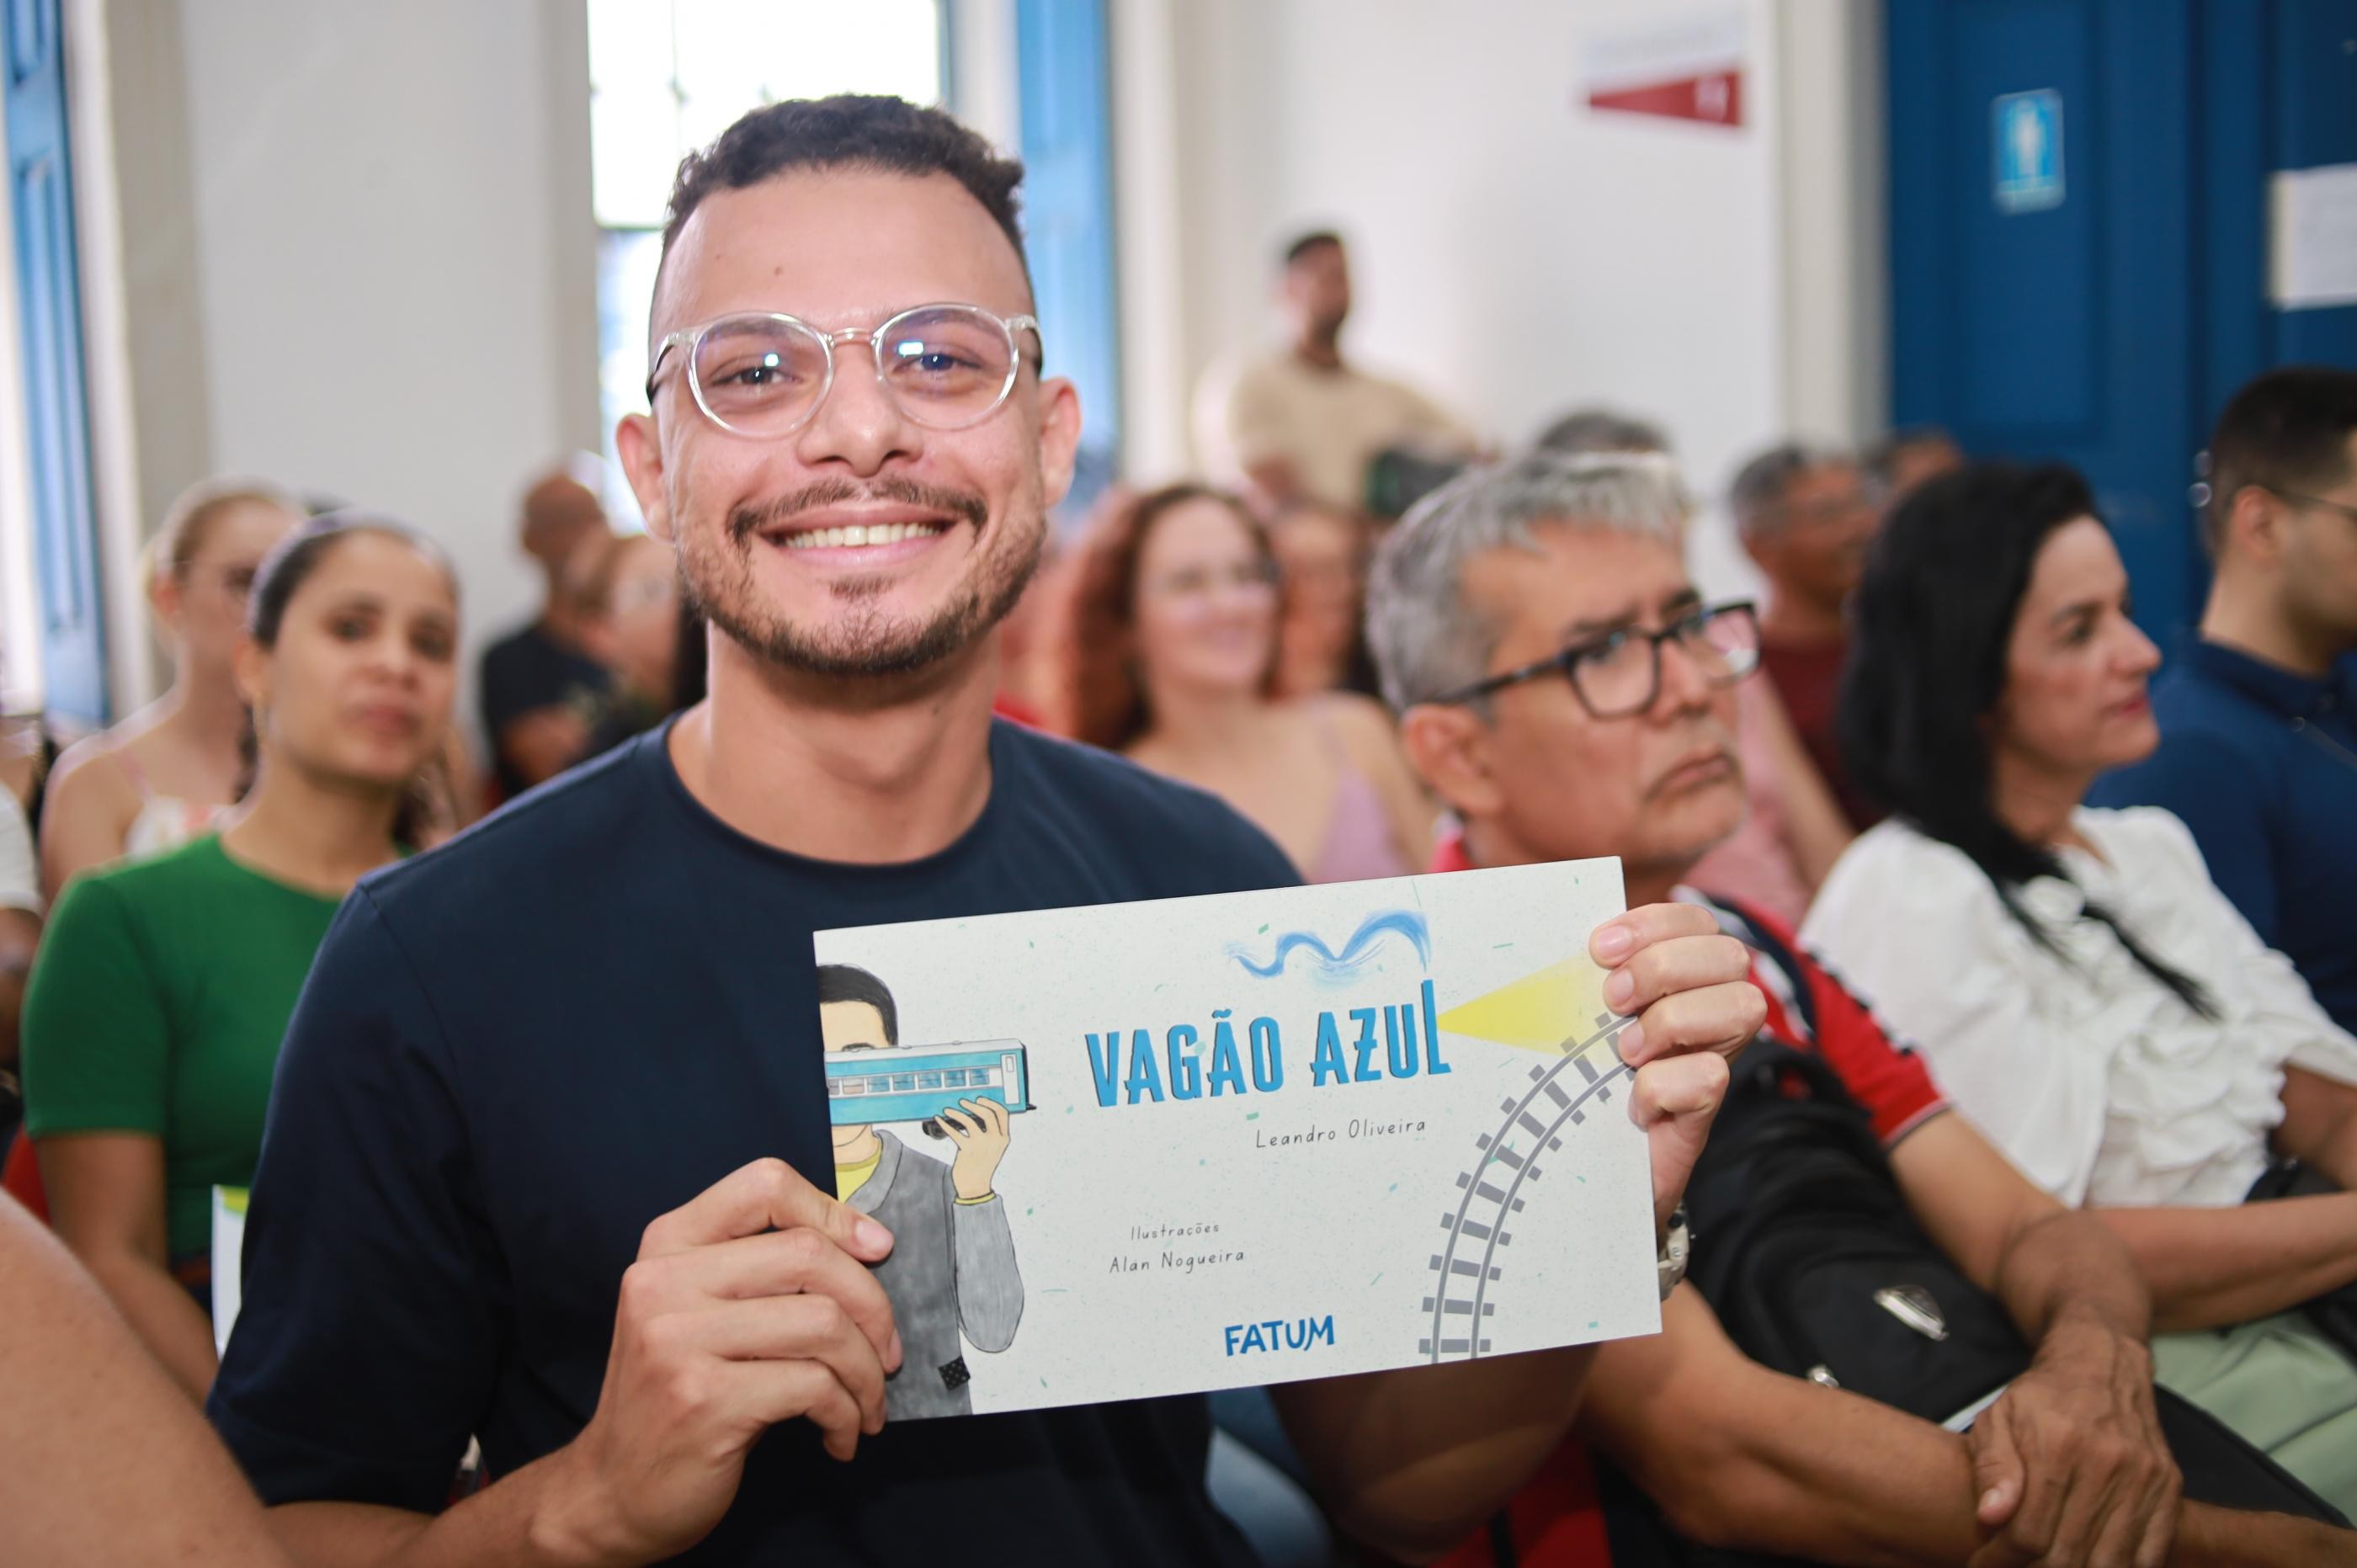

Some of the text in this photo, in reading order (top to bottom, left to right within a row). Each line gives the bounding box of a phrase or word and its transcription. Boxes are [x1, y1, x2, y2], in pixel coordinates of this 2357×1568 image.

[1084, 979, 1451, 1108] VAGÃO AZUL
[1256, 1118, 1426, 1148] Leandro Oliveira
[1131, 1222, 1220, 1241] Ilustrações
[1109, 1250, 1244, 1274] Alan Nogueira
[1224, 1315, 1335, 1357] FATUM
